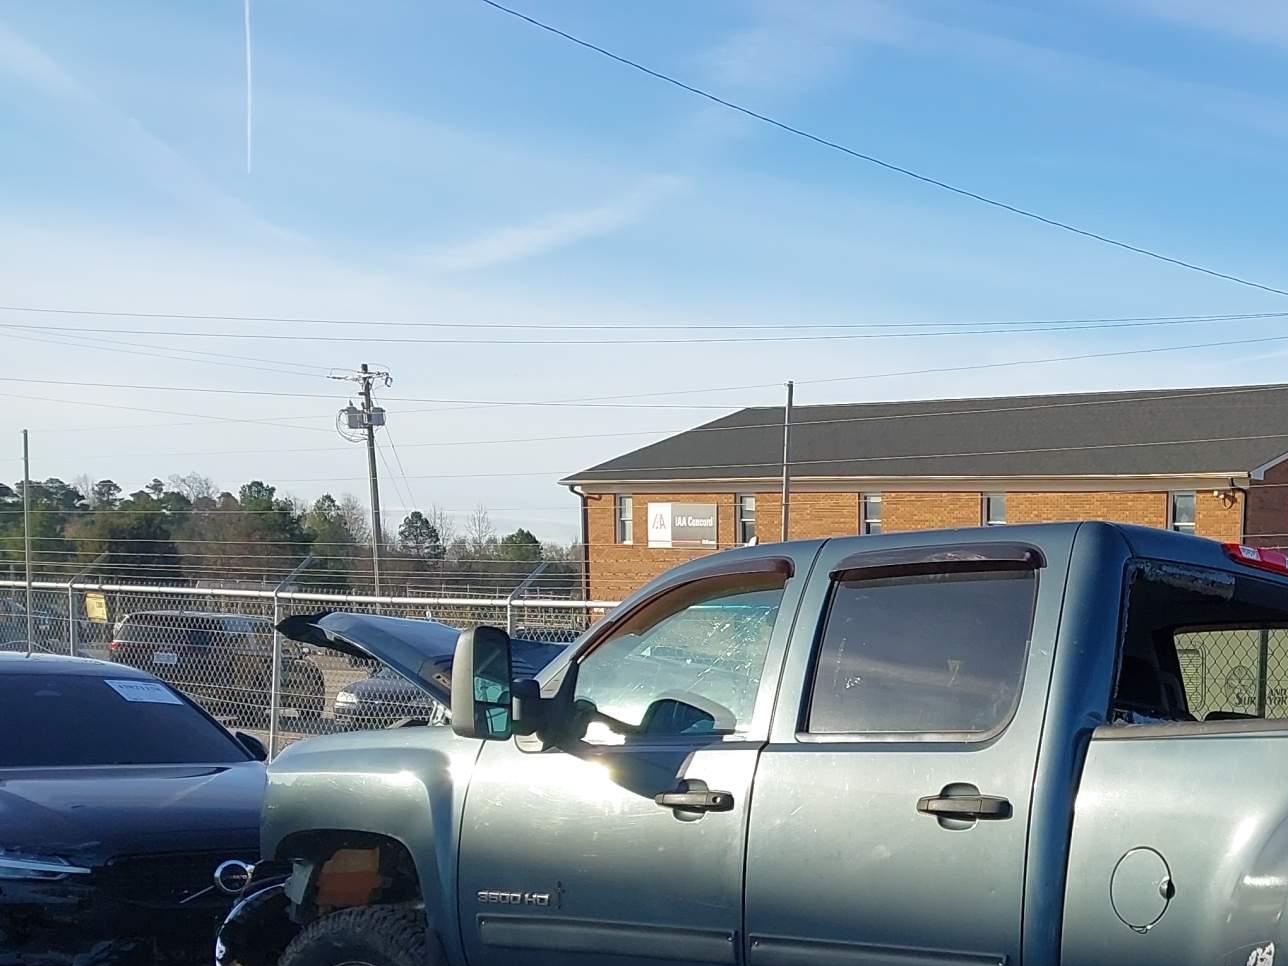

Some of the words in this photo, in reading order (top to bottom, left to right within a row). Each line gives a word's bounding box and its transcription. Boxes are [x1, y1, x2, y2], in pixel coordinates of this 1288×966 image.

[675, 516, 687, 527] IAA
[477, 891, 521, 904] 3500
[524, 893, 549, 906] HD
